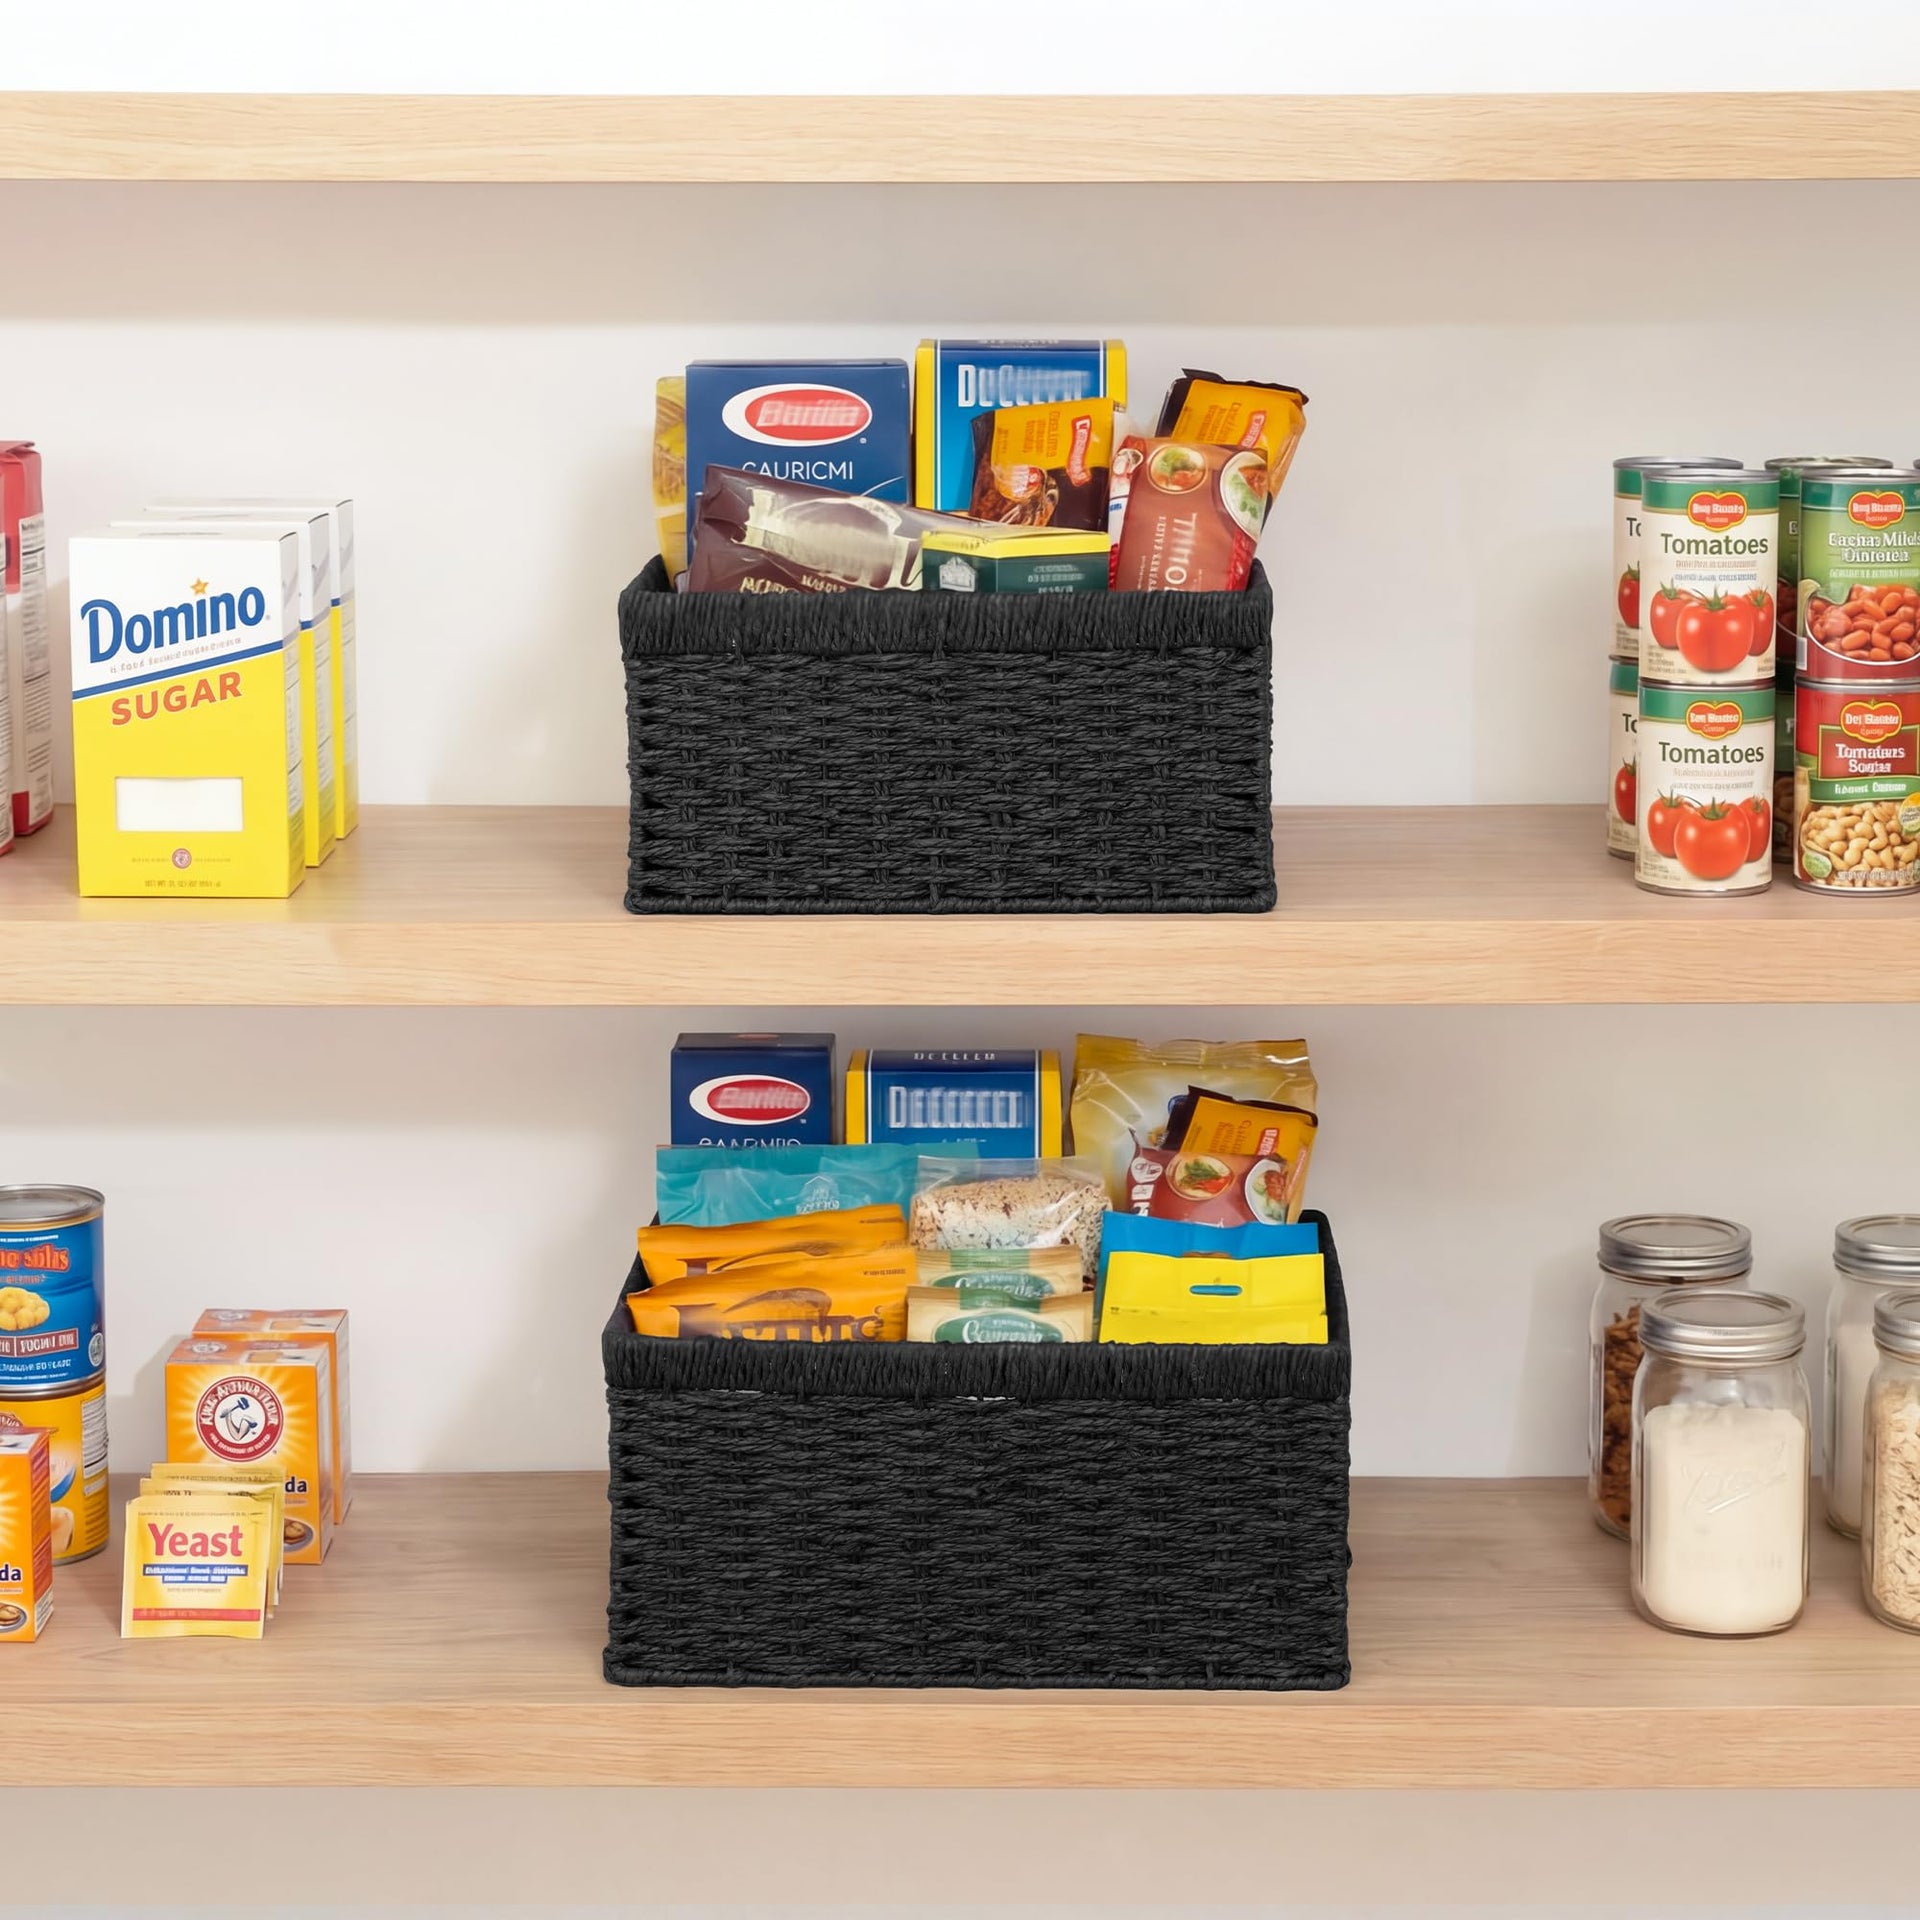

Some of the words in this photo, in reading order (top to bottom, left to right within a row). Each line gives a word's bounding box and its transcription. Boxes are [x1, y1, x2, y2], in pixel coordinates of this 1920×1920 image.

[1661, 533, 1769, 555] Tomatoes
[81, 586, 266, 664] Domino
[111, 671, 242, 726] SUGAR
[1659, 741, 1765, 764] Tomatoes
[147, 1523, 244, 1557] Yeast
